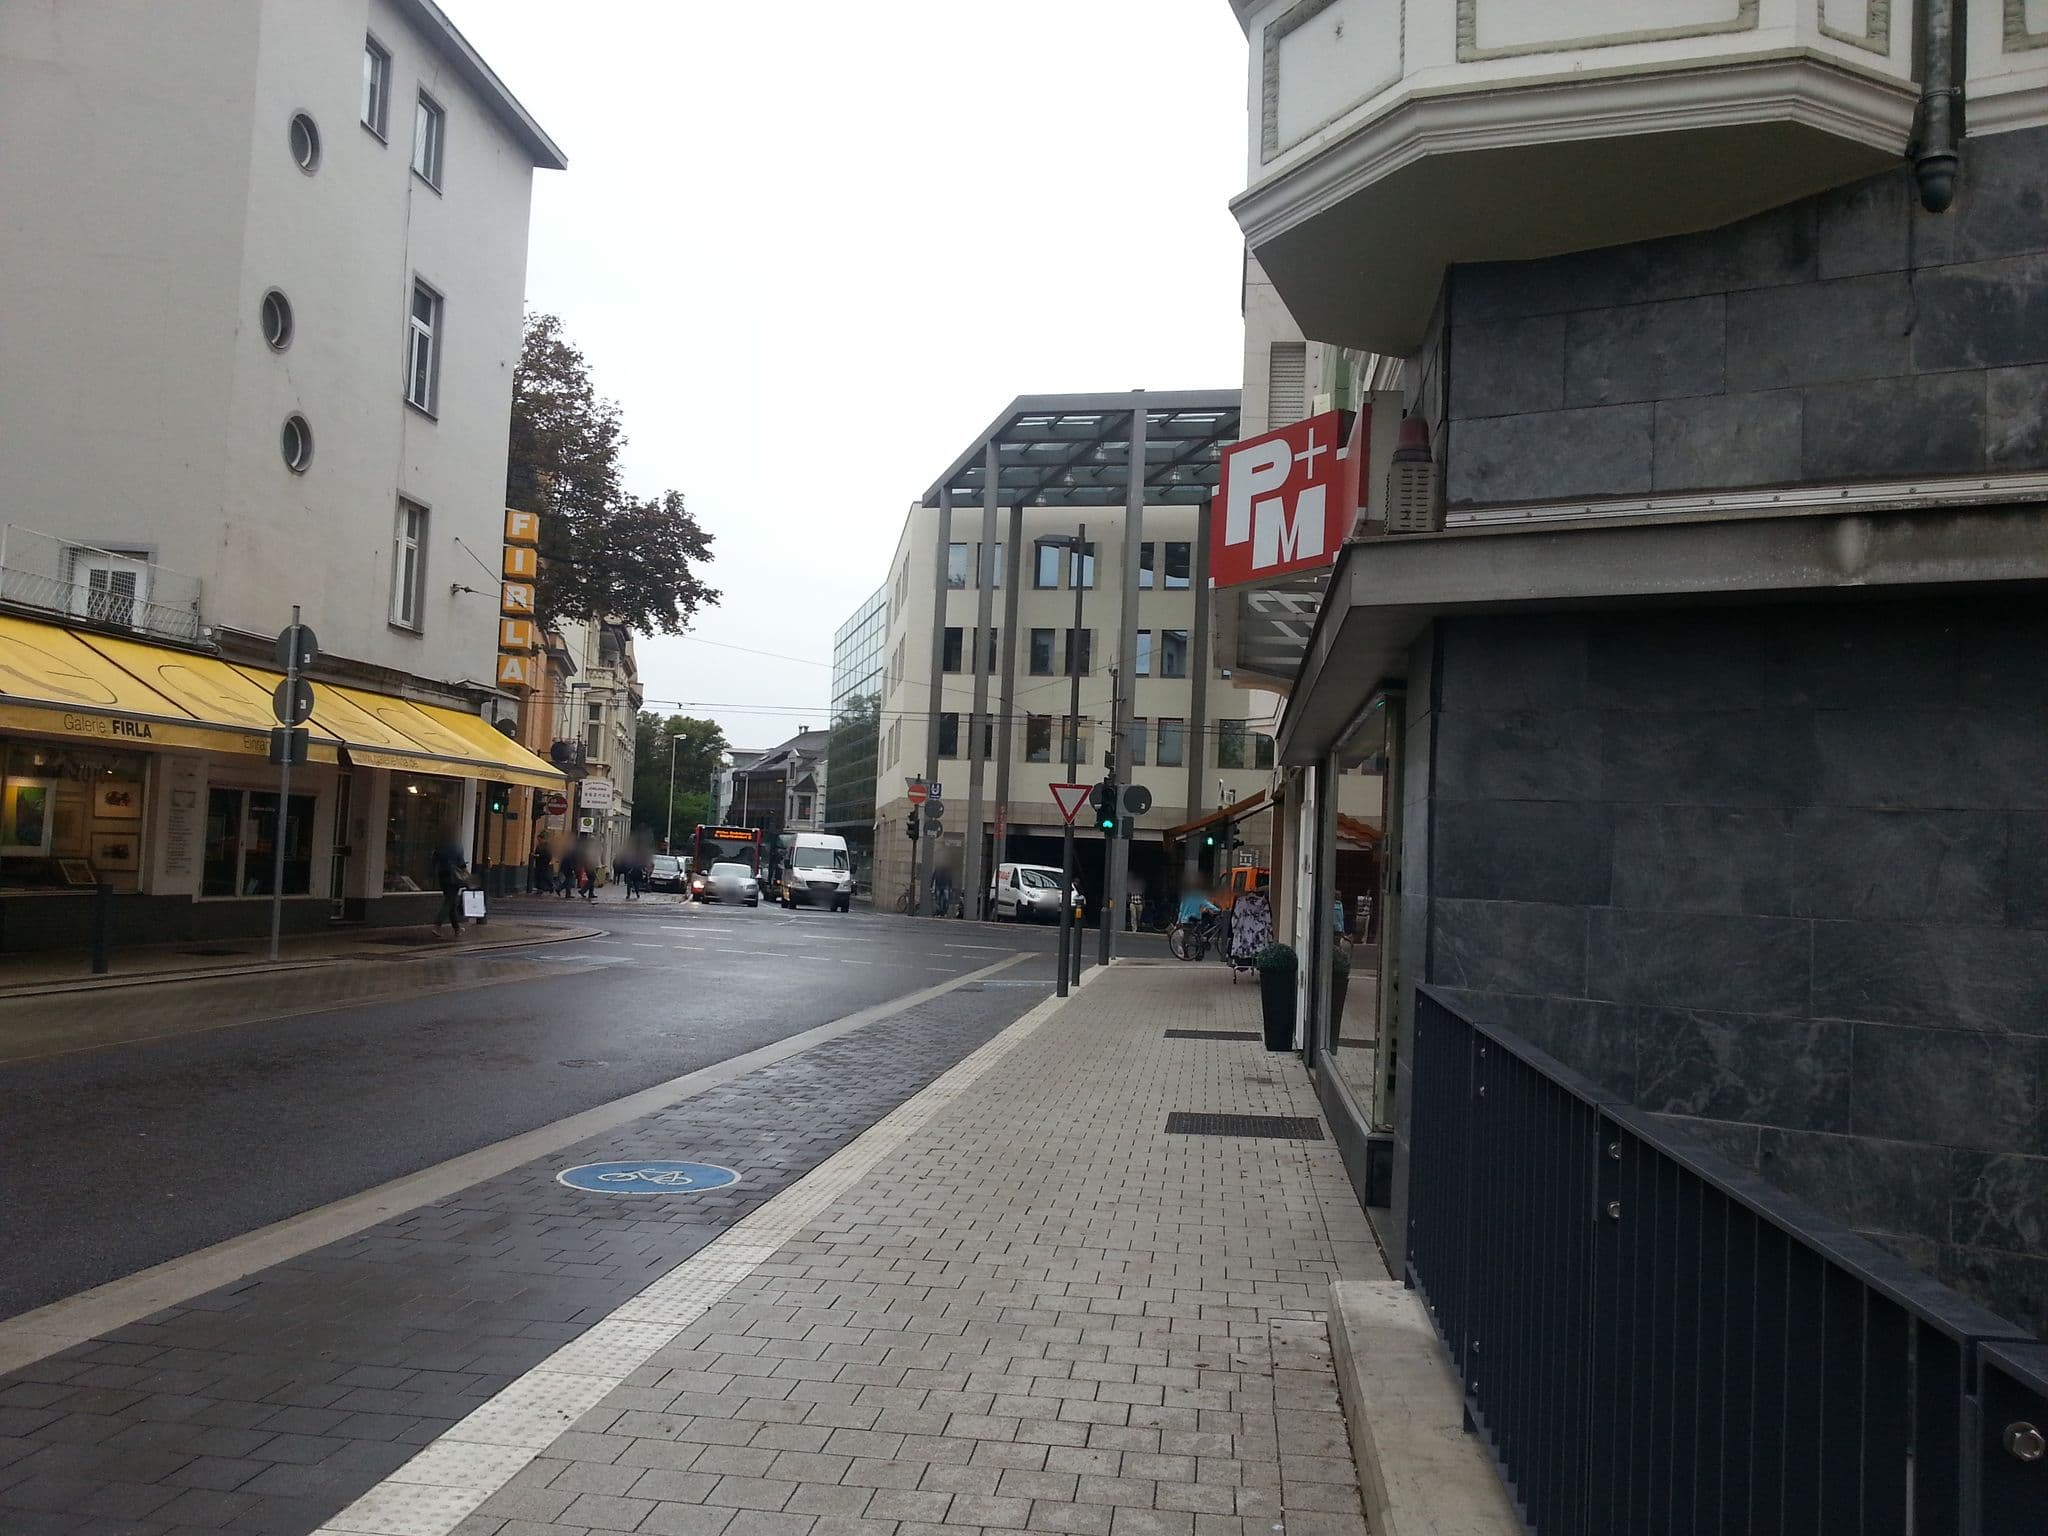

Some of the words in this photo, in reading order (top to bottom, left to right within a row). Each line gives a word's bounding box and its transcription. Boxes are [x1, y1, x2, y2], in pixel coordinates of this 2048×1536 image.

[502, 513, 530, 680] FIRLA
[63, 713, 106, 734] Galerie
[112, 719, 153, 738] FIRLA
